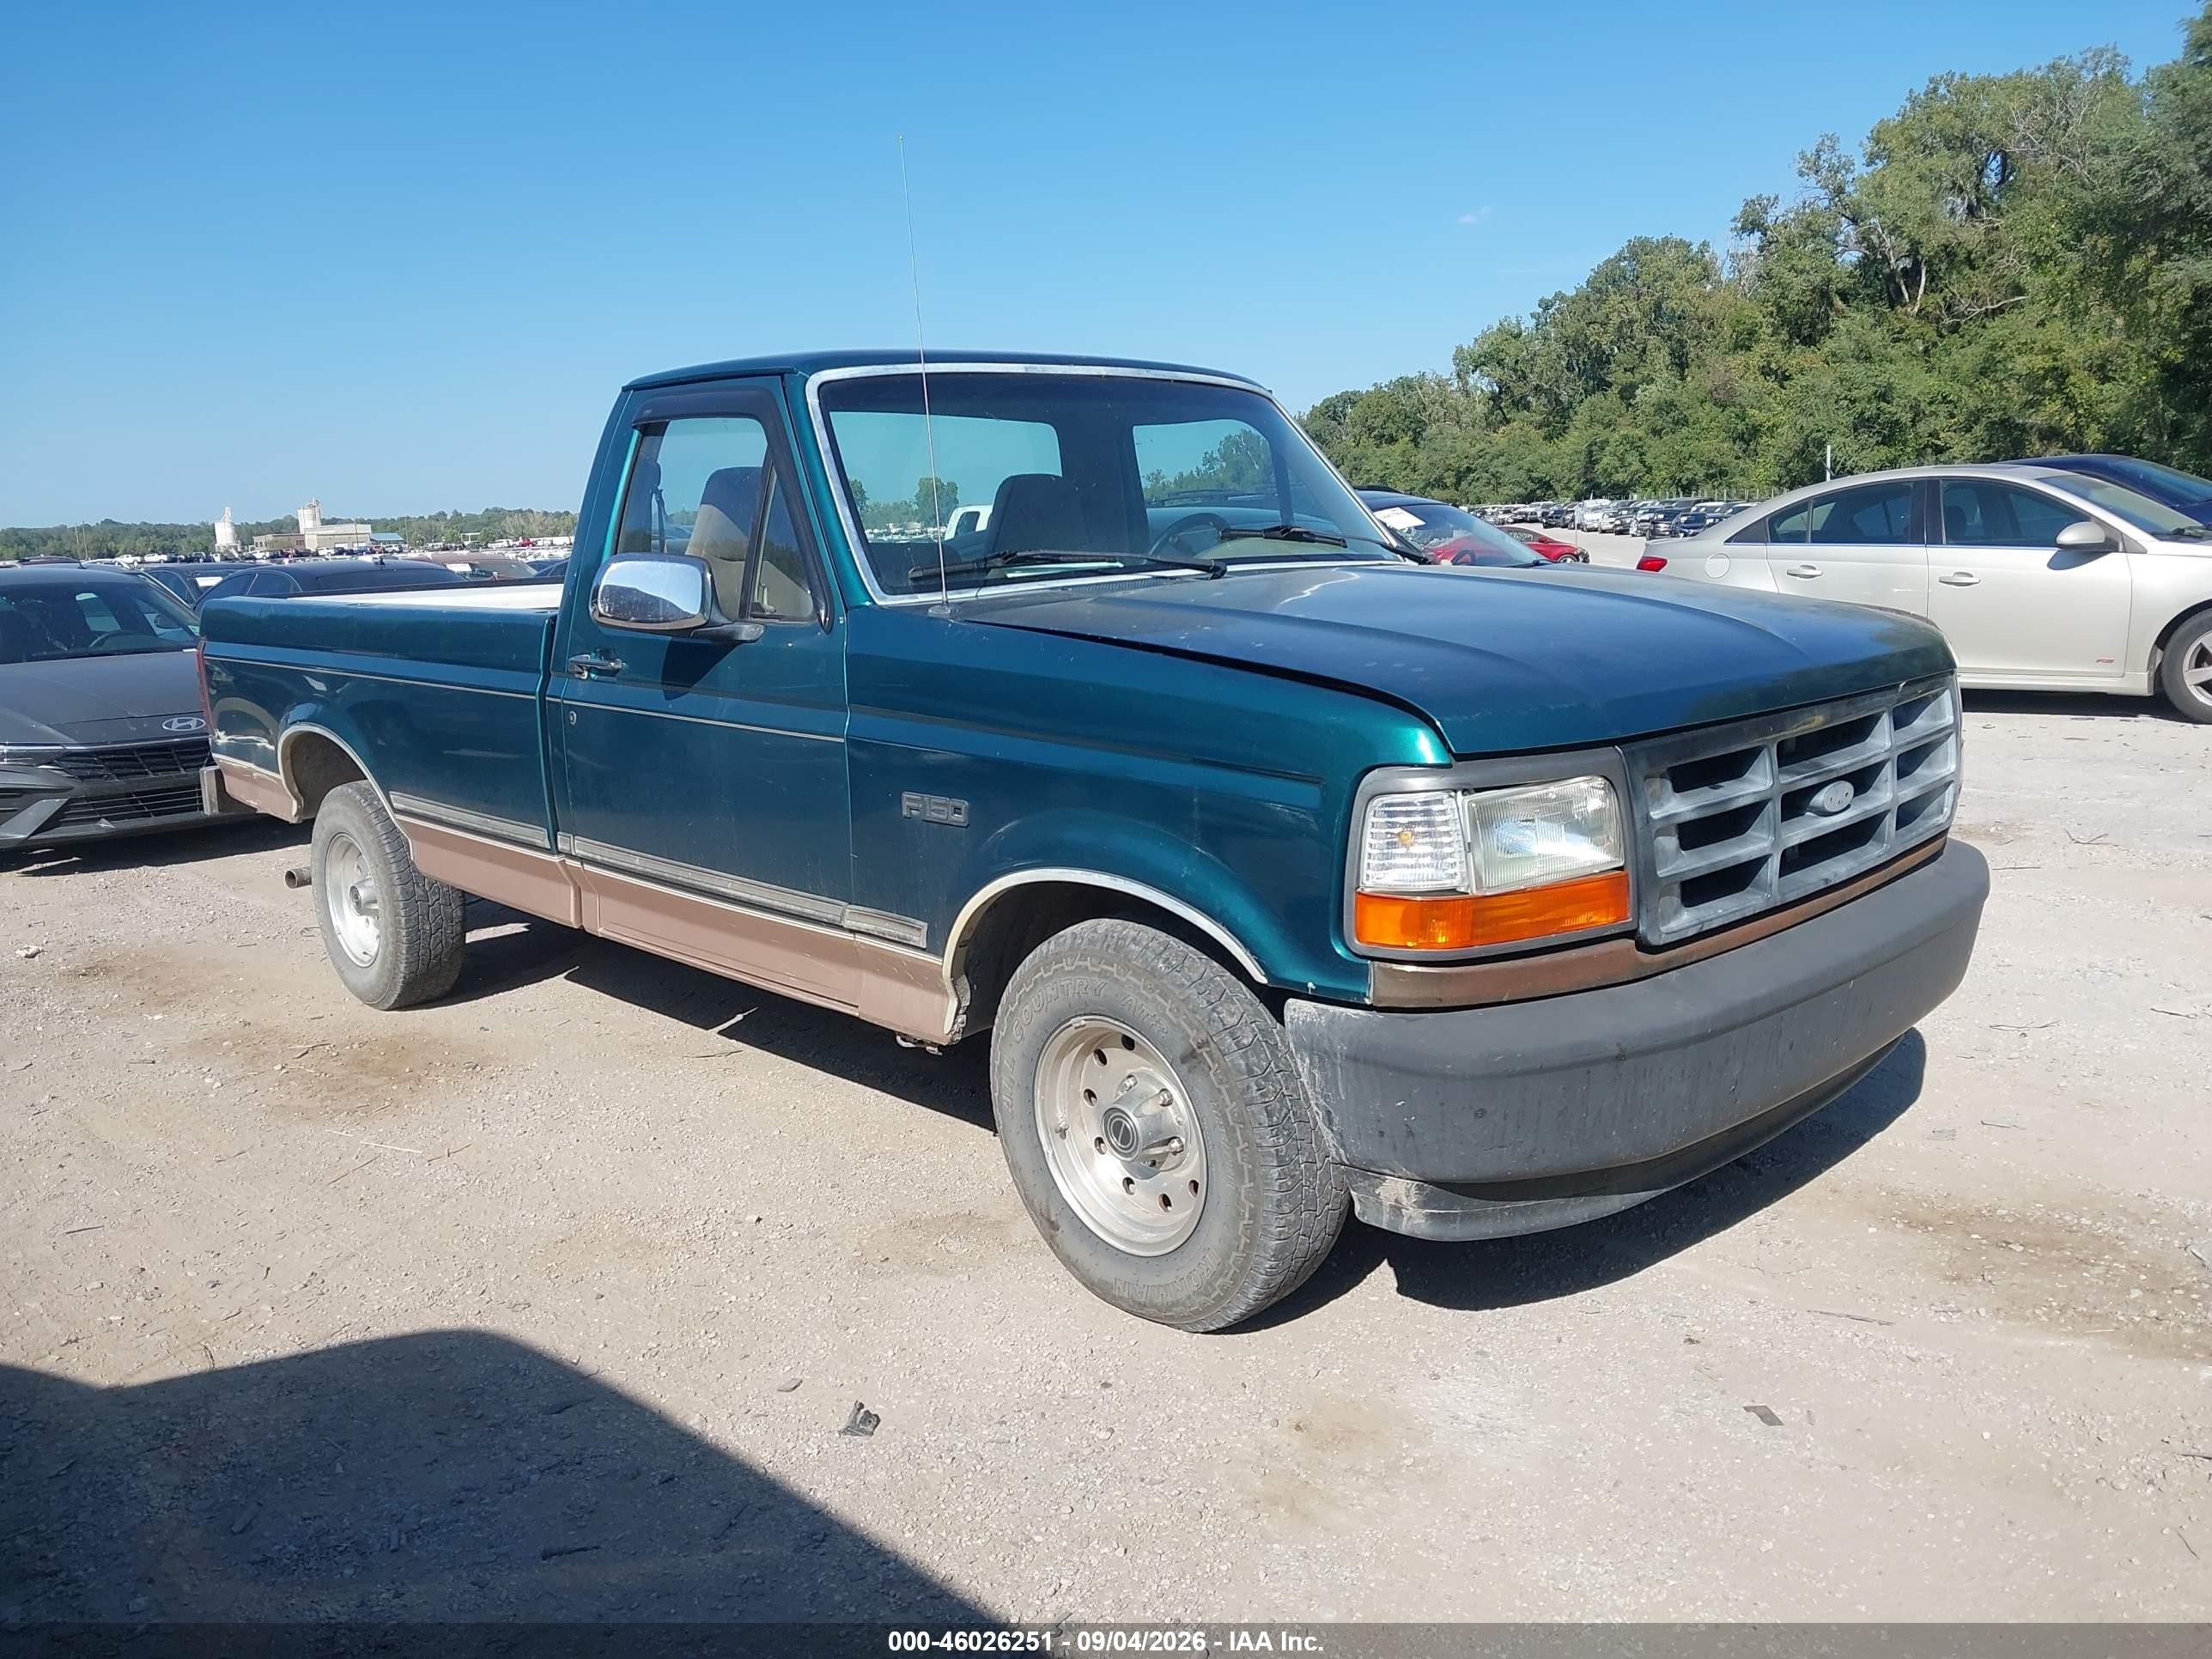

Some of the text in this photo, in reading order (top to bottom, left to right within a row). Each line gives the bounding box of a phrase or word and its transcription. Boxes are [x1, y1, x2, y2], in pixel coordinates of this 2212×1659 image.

[1002, 1056, 1017, 1114] ALL
[1012, 975, 1109, 1044] COUNTRY
[1113, 1247, 1222, 1304] IRONMAN
